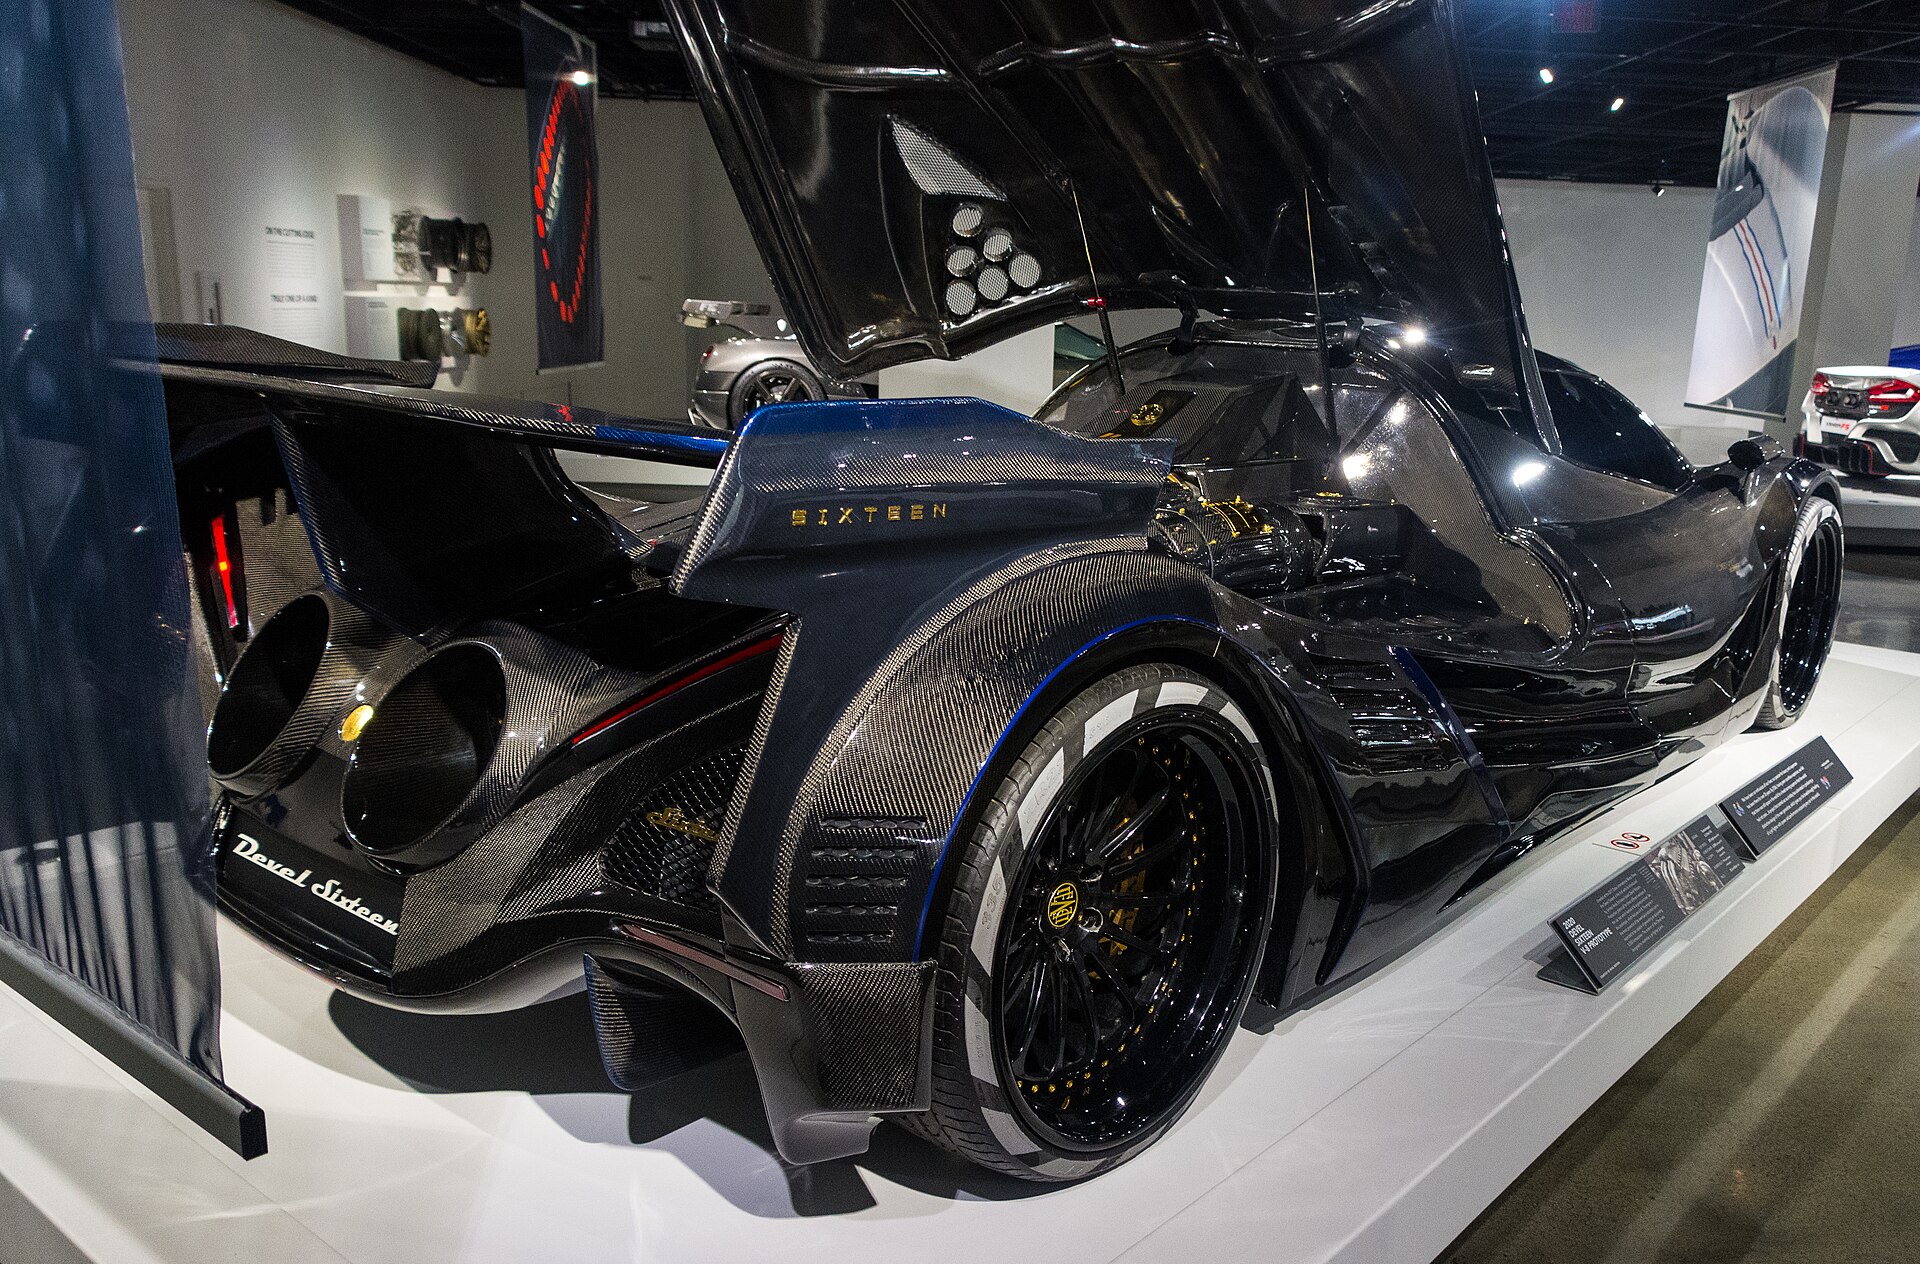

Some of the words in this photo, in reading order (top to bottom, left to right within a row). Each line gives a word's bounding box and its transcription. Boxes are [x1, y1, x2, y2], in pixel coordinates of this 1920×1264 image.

[791, 503, 947, 527] SIXTEEN
[232, 833, 313, 888] Devel
[311, 879, 401, 936] Sixteen
[1562, 917, 1576, 930] 2020
[1568, 924, 1585, 938] DEVEL
[1574, 929, 1594, 947] SIXTEEN
[1580, 944, 1591, 955] V-8
[1587, 927, 1613, 950] PROTOTYPE
